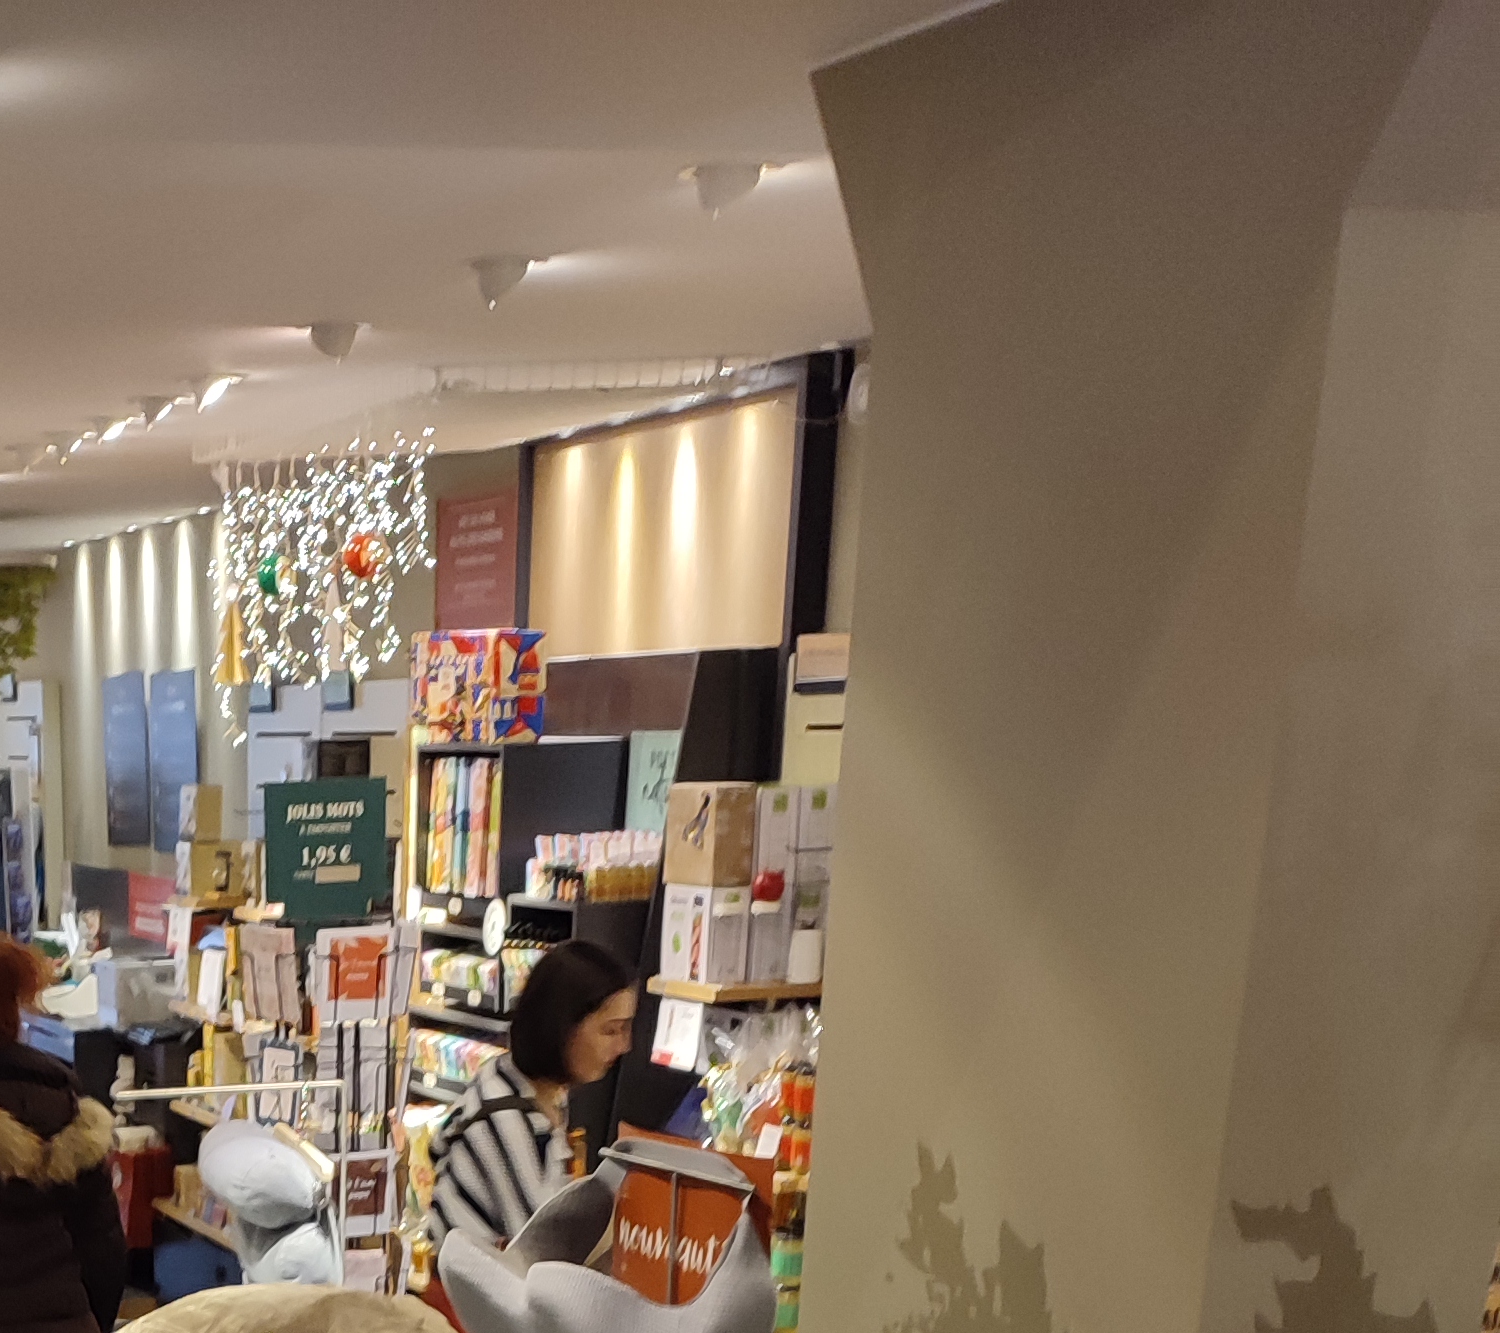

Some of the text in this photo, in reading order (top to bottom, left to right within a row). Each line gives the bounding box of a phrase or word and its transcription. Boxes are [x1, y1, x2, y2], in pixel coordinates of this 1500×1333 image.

[326, 799, 365, 819] MOTS
[302, 843, 352, 868] 1,95 €
